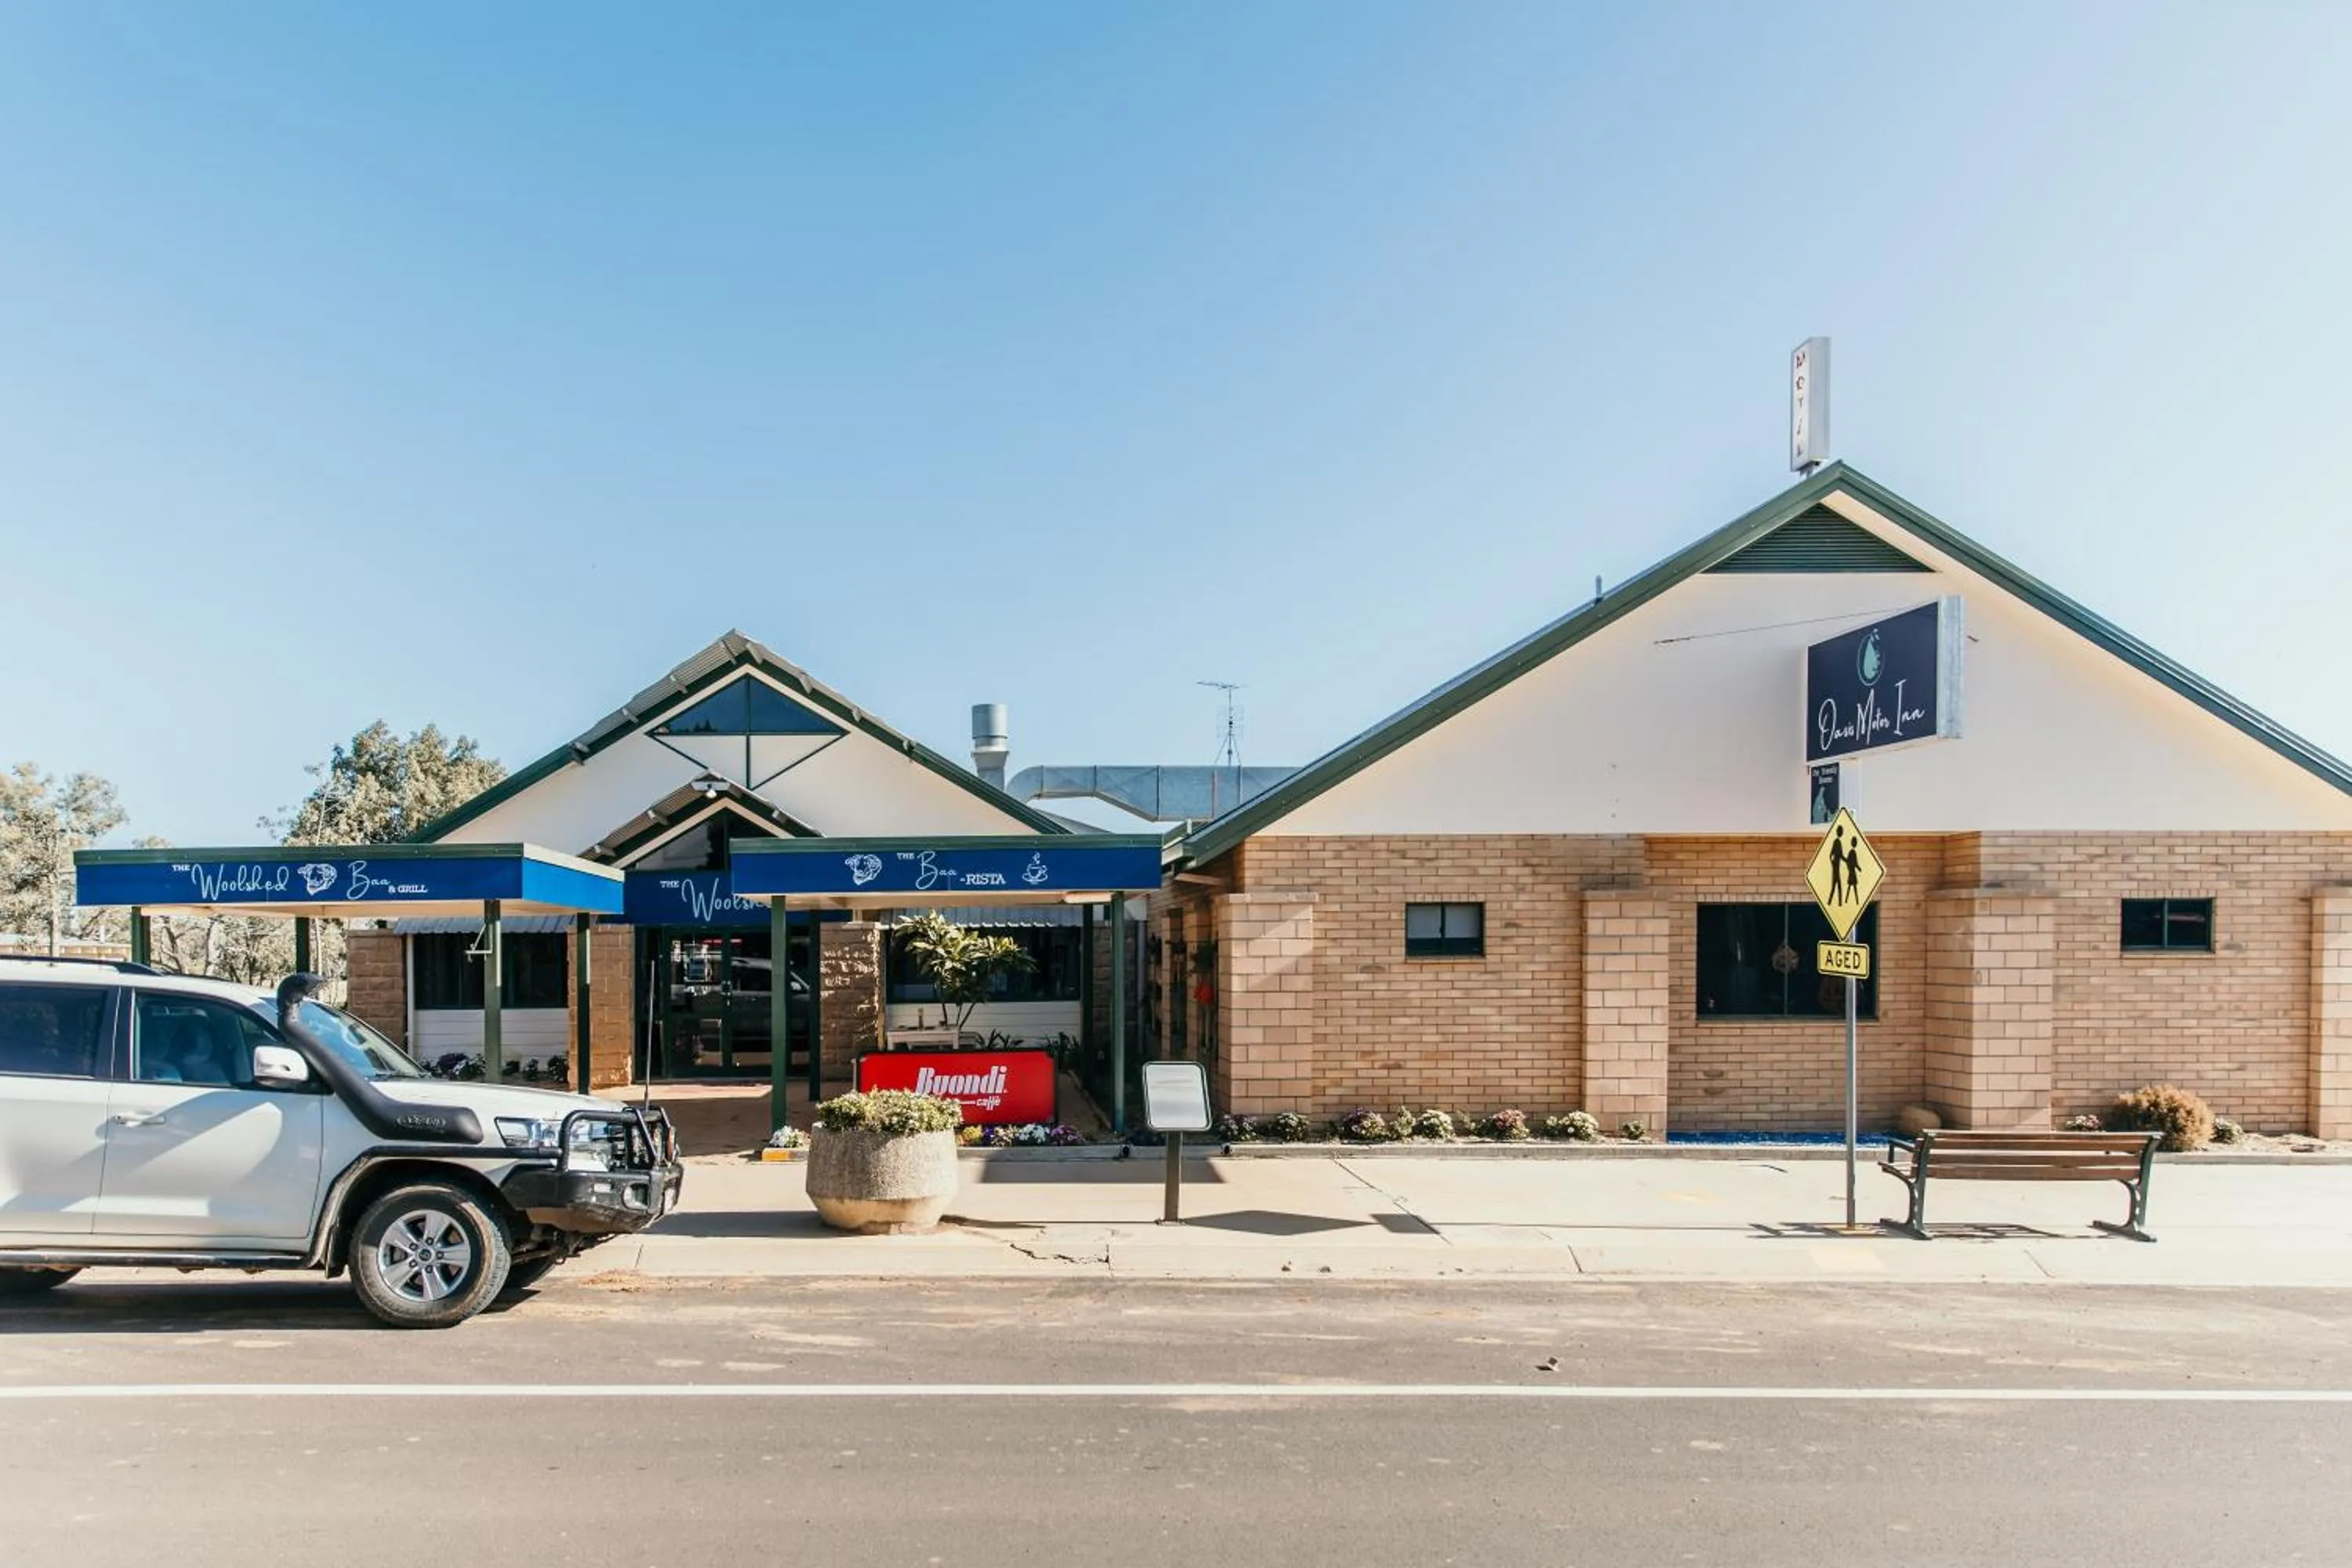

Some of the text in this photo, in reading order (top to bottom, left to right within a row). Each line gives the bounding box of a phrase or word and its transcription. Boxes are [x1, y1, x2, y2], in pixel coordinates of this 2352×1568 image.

[1818, 679, 1925, 750] Oasis Motor Inn
[191, 863, 289, 901] Woolshed
[346, 860, 390, 900] Baa
[397, 884, 429, 894] GRILL
[897, 851, 1007, 890] THE Baa -RISTA
[681, 877, 773, 922] Wools
[1824, 949, 1861, 969] AGED
[915, 1065, 1008, 1095] Buondi
